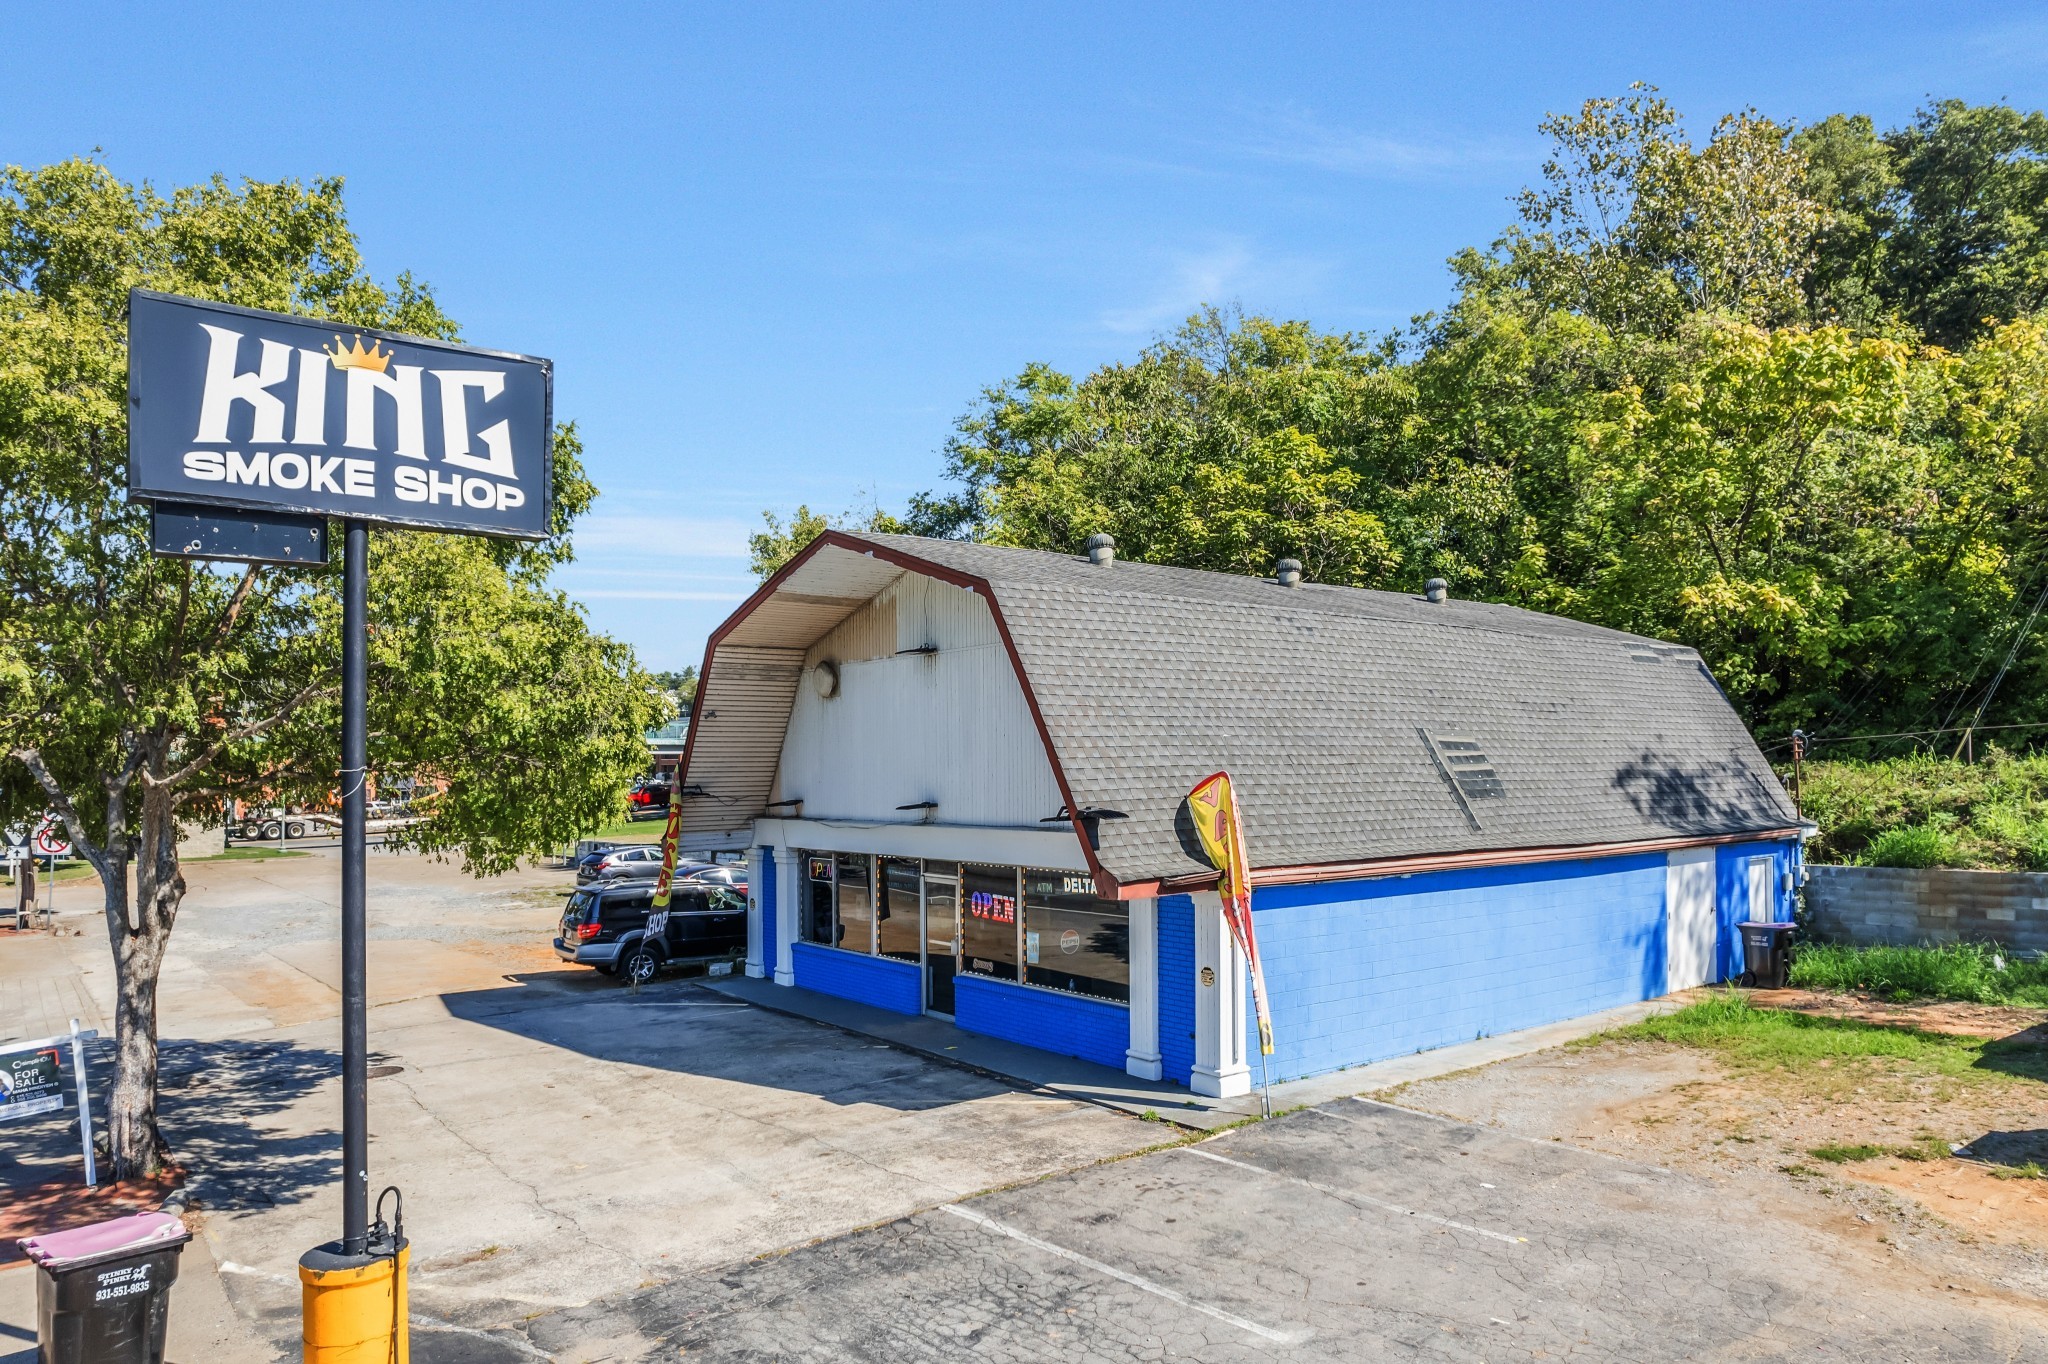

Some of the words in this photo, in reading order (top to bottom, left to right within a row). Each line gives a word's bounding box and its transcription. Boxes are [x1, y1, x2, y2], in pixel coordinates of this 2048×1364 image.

[192, 323, 519, 480] KING
[183, 452, 375, 498] SMOKE
[394, 466, 525, 511] SHOP
[1036, 883, 1053, 893] ATM
[1063, 877, 1098, 894] DELTA
[971, 891, 1015, 924] OPEN
[14, 1069, 39, 1080] FOR
[15, 1076, 46, 1088] SALE
[97, 1267, 133, 1281] STINKY
[102, 1274, 132, 1286] PINKY
[95, 1280, 150, 1301] 931-551-9835
